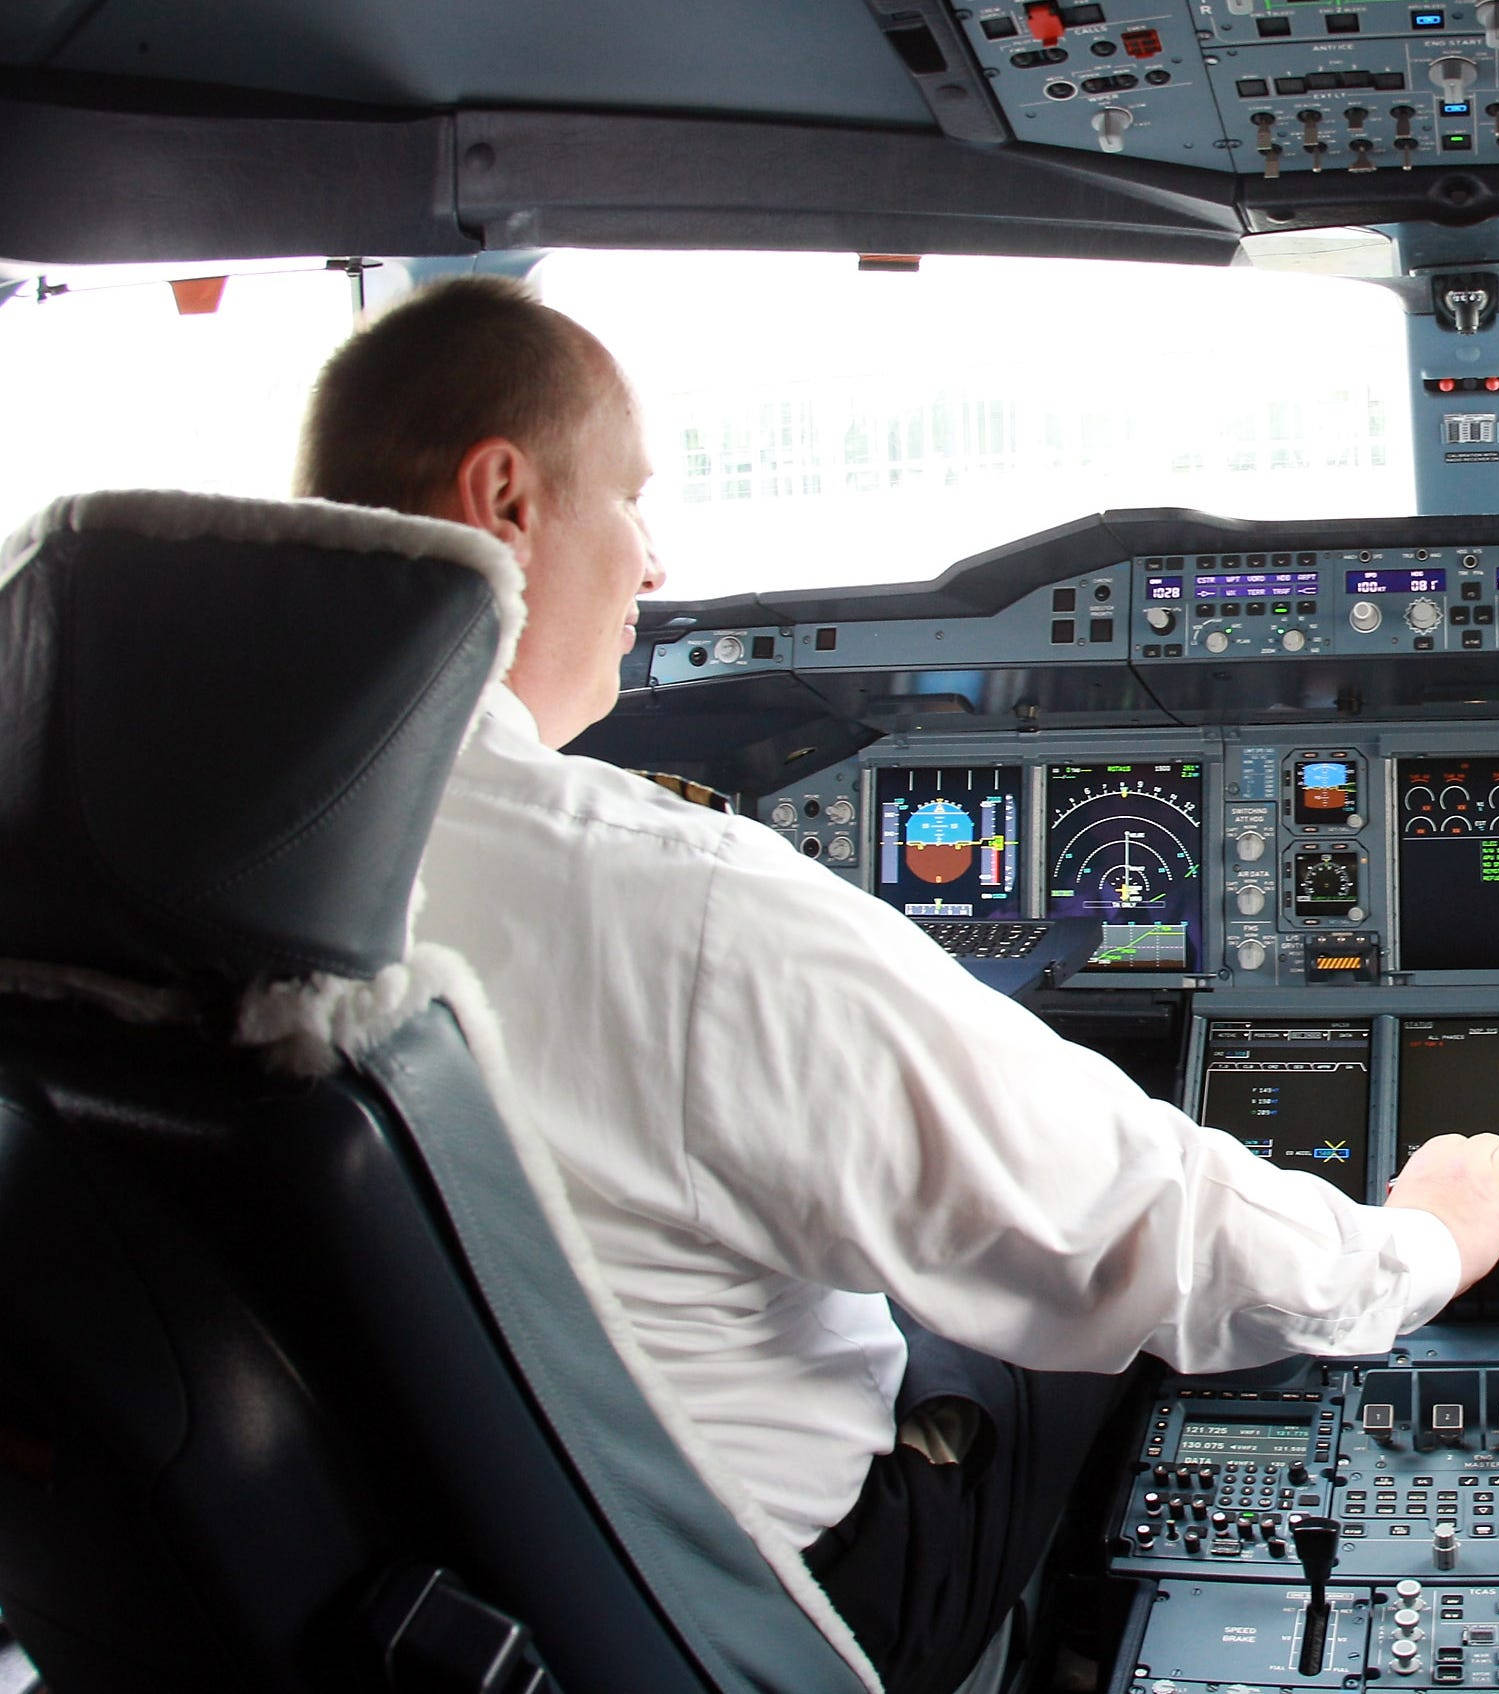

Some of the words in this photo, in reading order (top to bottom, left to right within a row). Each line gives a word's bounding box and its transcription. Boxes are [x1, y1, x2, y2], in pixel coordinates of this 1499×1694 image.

[1200, 6, 1212, 15] R
[1074, 27, 1108, 35] CALLS
[1449, 39, 1482, 47] START
[1196, 577, 1216, 585] CSTR
[1152, 587, 1181, 599] 1028
[1185, 1426, 1228, 1434] 121.725
[1182, 1441, 1225, 1450] 130.075
[1224, 1626, 1257, 1634] SPEED
[1222, 1635, 1256, 1643] BRAKE
